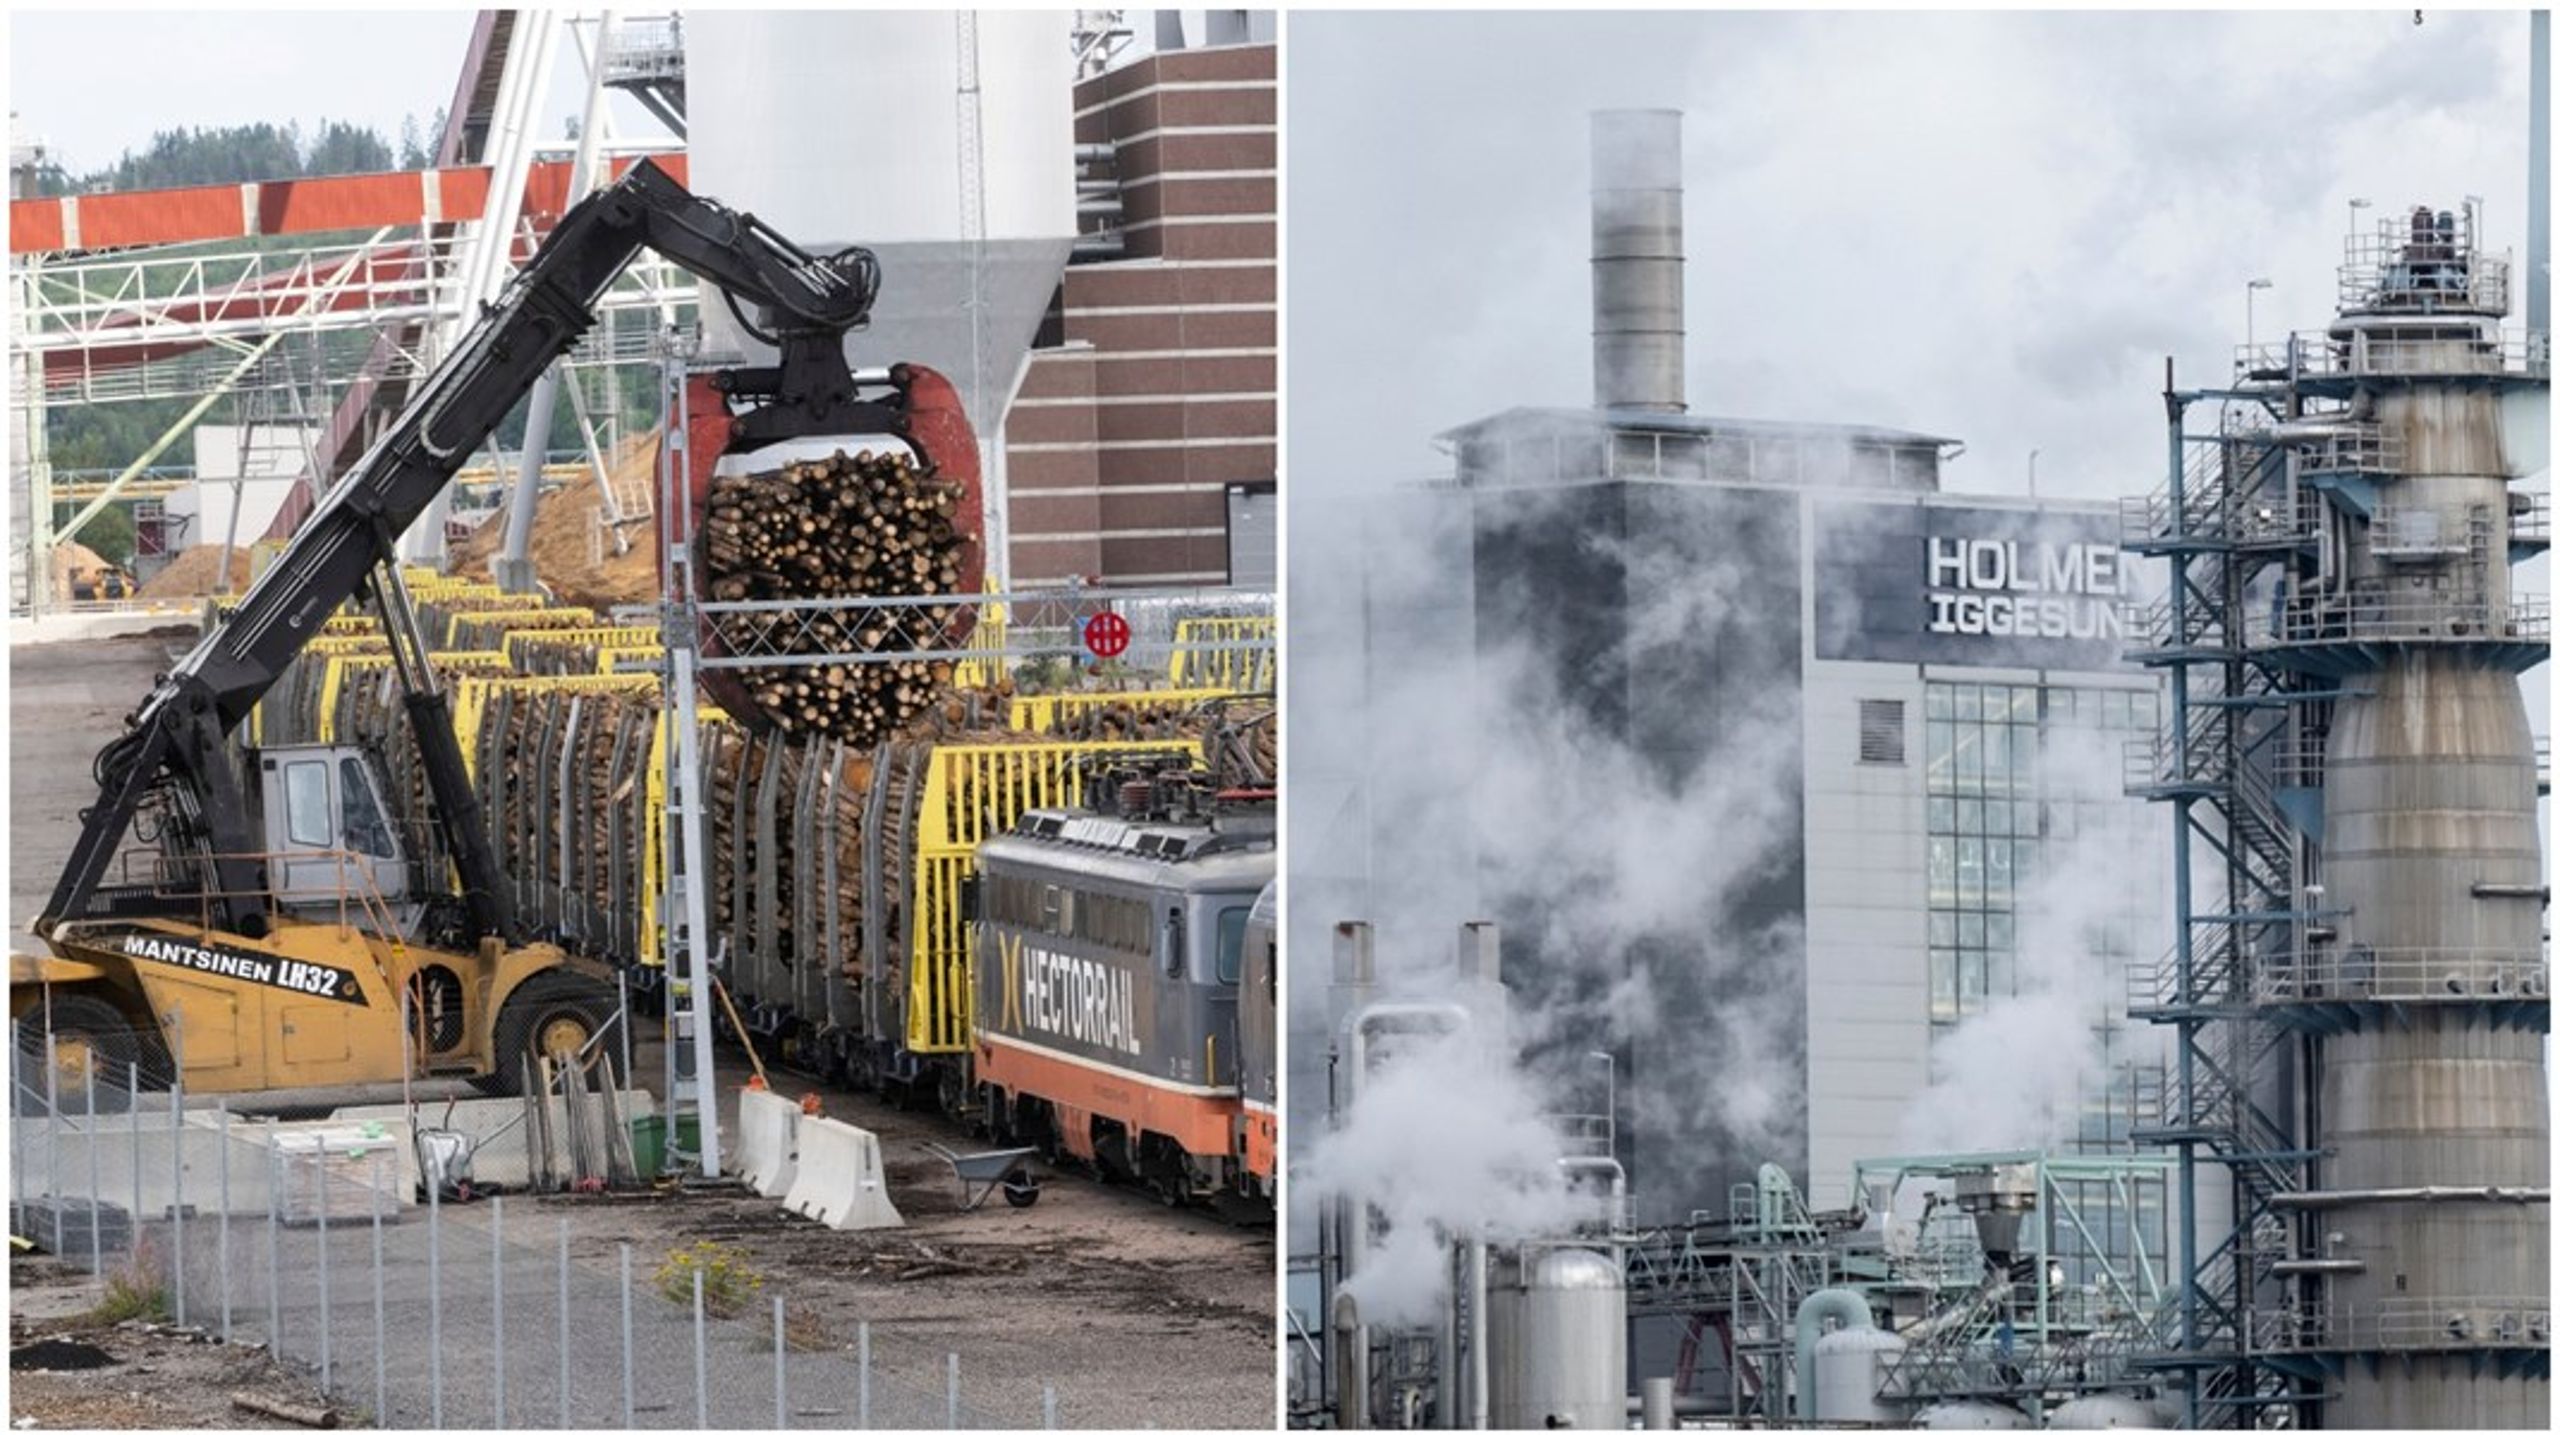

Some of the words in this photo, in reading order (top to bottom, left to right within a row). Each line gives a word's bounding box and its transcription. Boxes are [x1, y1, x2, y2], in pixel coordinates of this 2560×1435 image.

[125, 935, 271, 982] MANTSINEN
[278, 960, 338, 997] LH32
[1025, 948, 1140, 1055] HECTORRAIL
